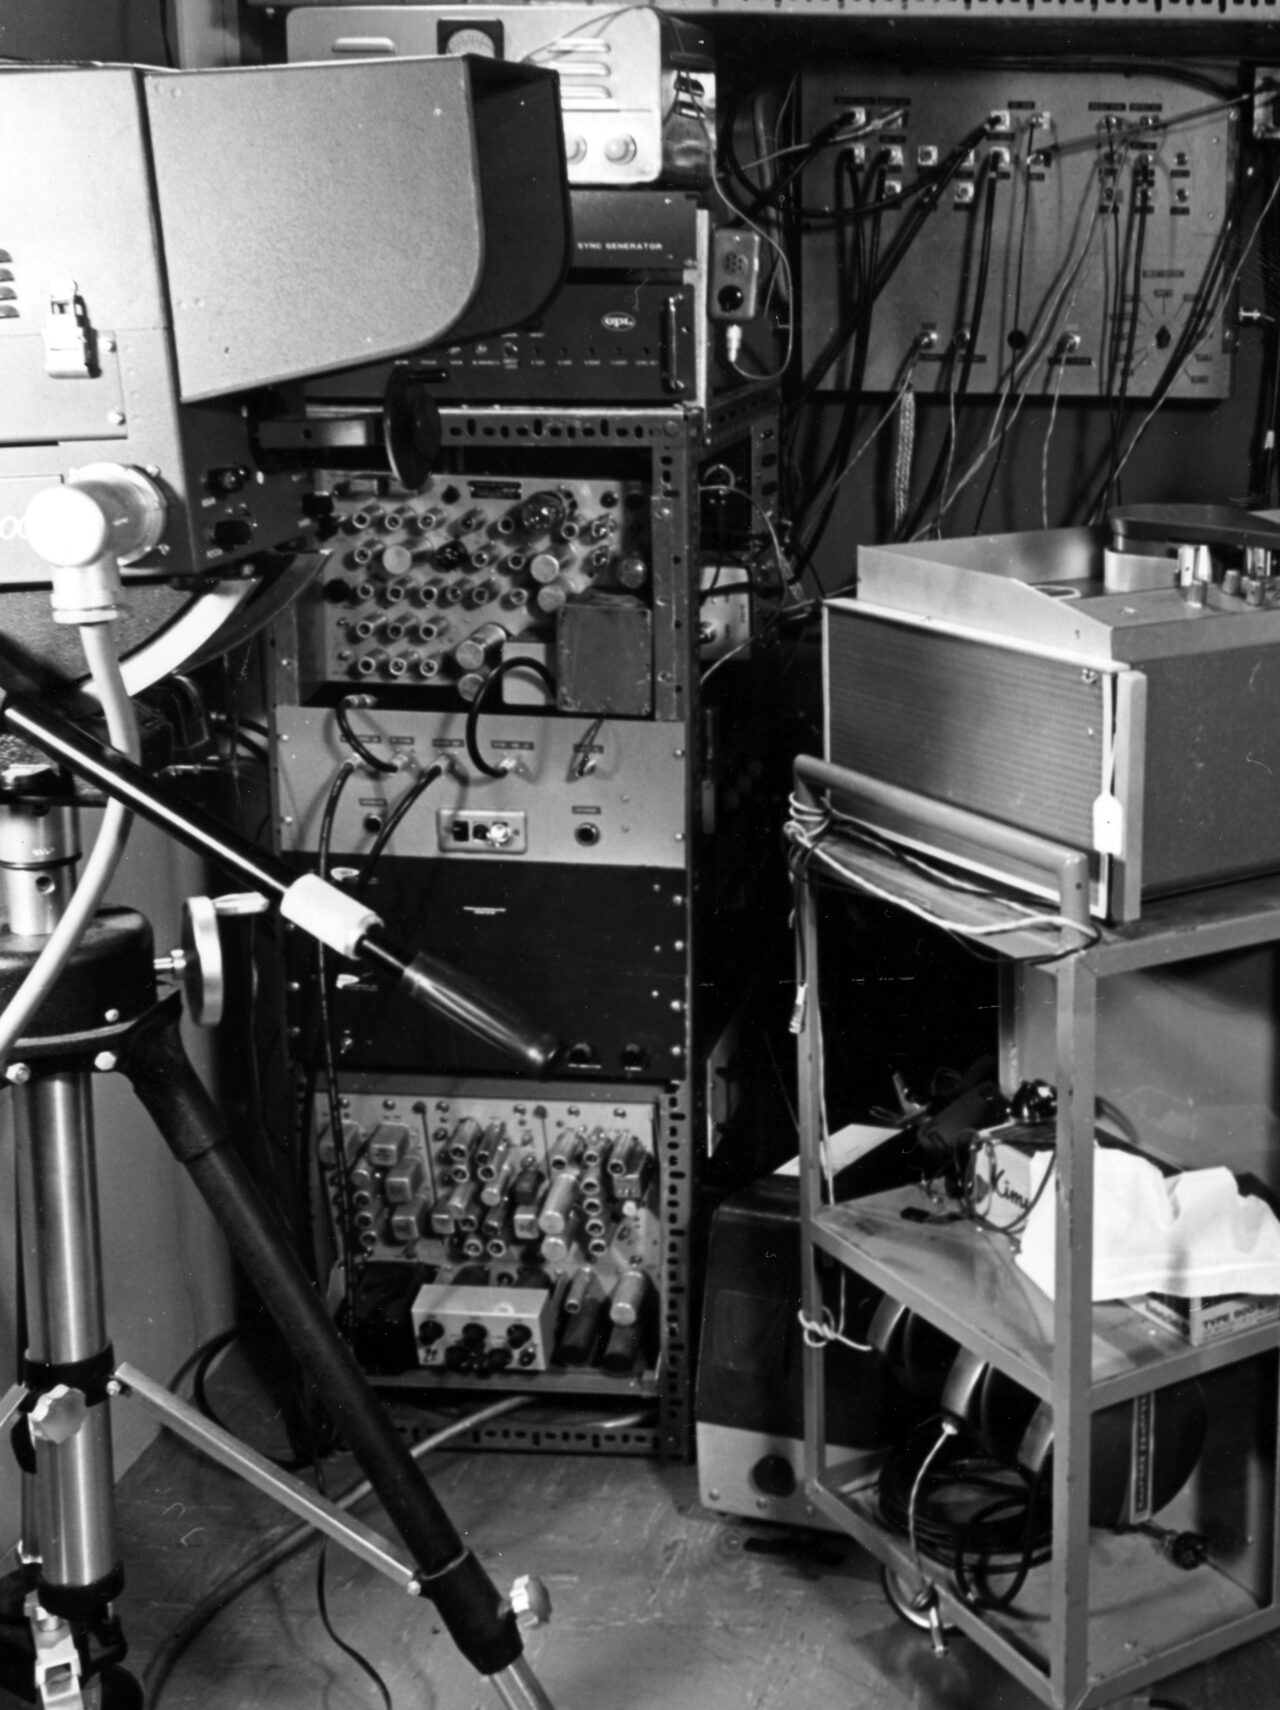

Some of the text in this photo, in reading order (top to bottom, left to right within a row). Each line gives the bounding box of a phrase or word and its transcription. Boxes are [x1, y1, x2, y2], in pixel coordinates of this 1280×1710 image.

[577, 242, 663, 251] SYNC GENERATOR
[1203, 1313, 1230, 1329] TYPE
